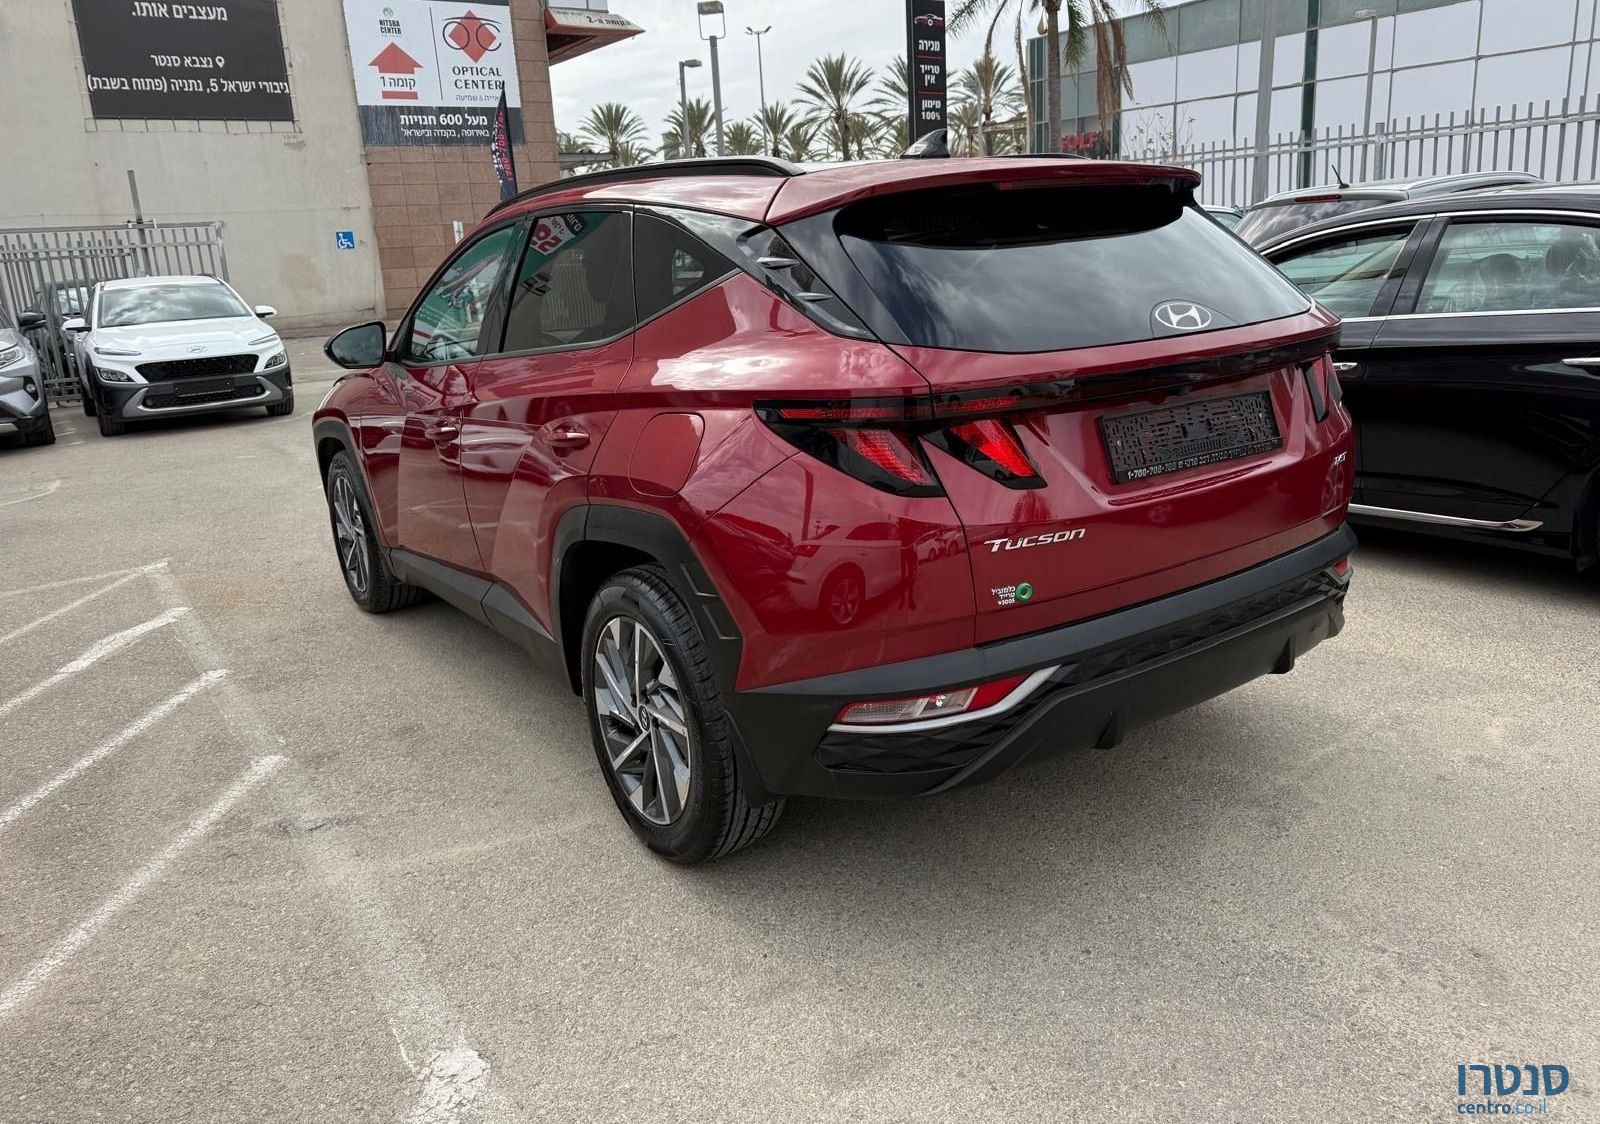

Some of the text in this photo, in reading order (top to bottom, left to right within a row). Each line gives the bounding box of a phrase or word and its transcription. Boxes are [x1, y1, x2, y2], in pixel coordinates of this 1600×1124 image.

[131, 1, 228, 20] מעצבים אותו.
[380, 26, 402, 35] CENTER
[918, 39, 941, 52] מכירה
[150, 54, 213, 68] נצבא סנטר
[452, 65, 502, 77] OPTICAL
[920, 64, 940, 74] טרייד
[87, 74, 290, 94] גיבורי ישראל 5, נתניה (פתוח בשבת)
[379, 75, 416, 90] קומה 1
[454, 78, 504, 90] CENTER
[924, 74, 936, 87] אין
[921, 99, 942, 111] מימון
[400, 113, 488, 126] מעל 600 חנויות
[921, 111, 941, 120] 100%
